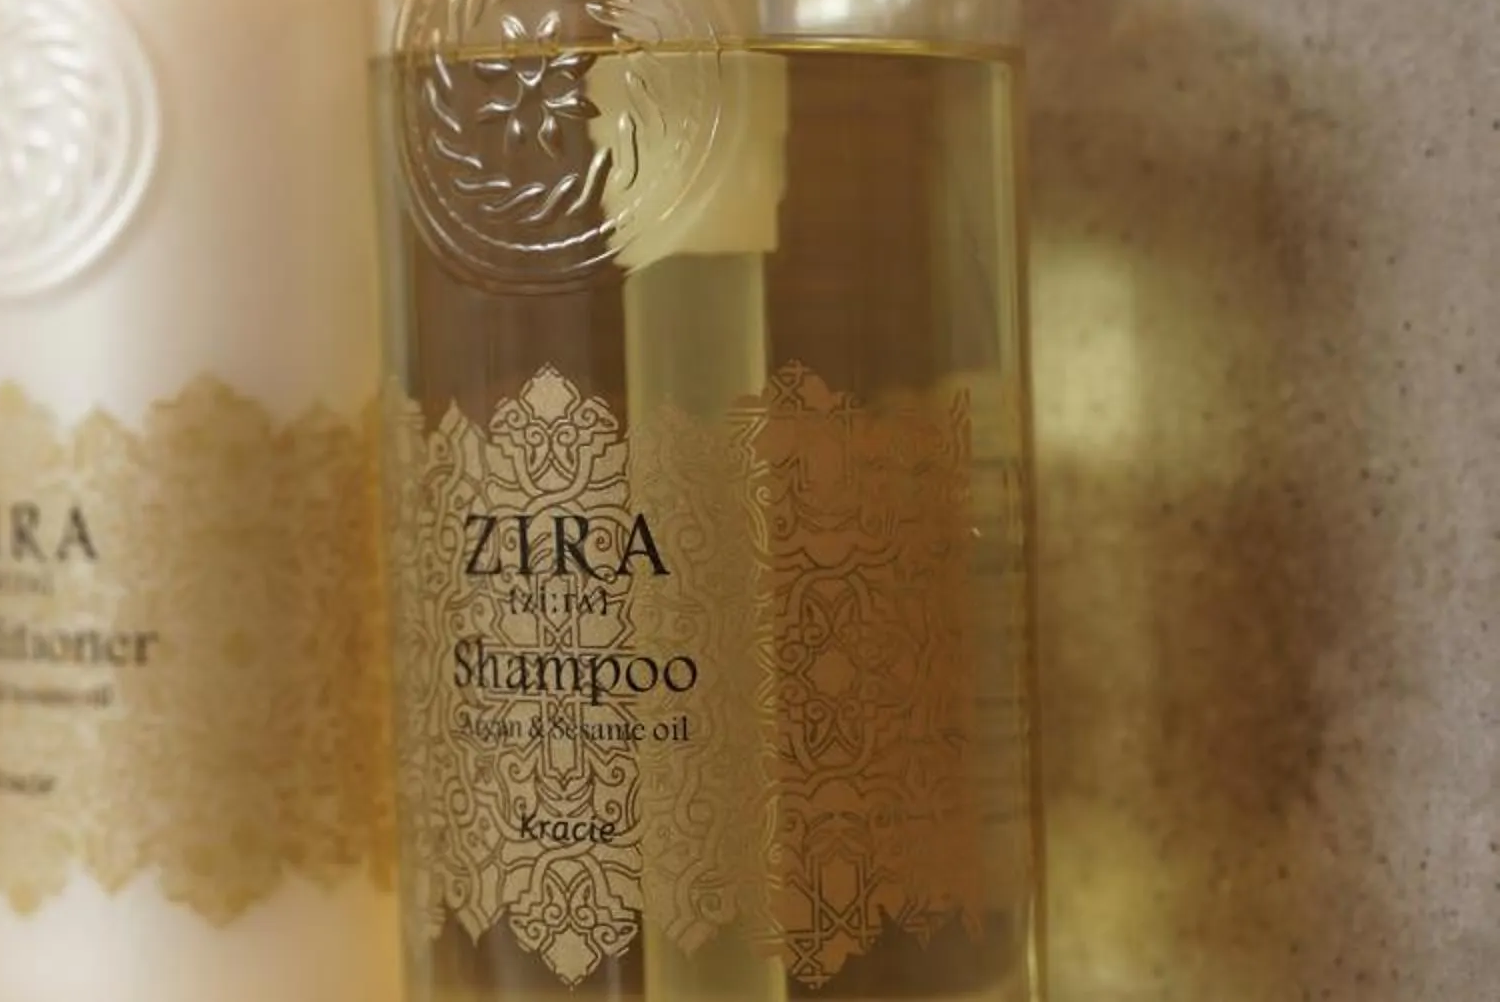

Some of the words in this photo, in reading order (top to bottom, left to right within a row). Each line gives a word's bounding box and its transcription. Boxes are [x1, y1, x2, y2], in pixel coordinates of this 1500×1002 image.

[464, 512, 670, 579] ZIRA
[454, 636, 697, 706] Shampoo
[529, 716, 547, 741] &
[653, 715, 691, 742] oil
[520, 812, 616, 843] Kracie
